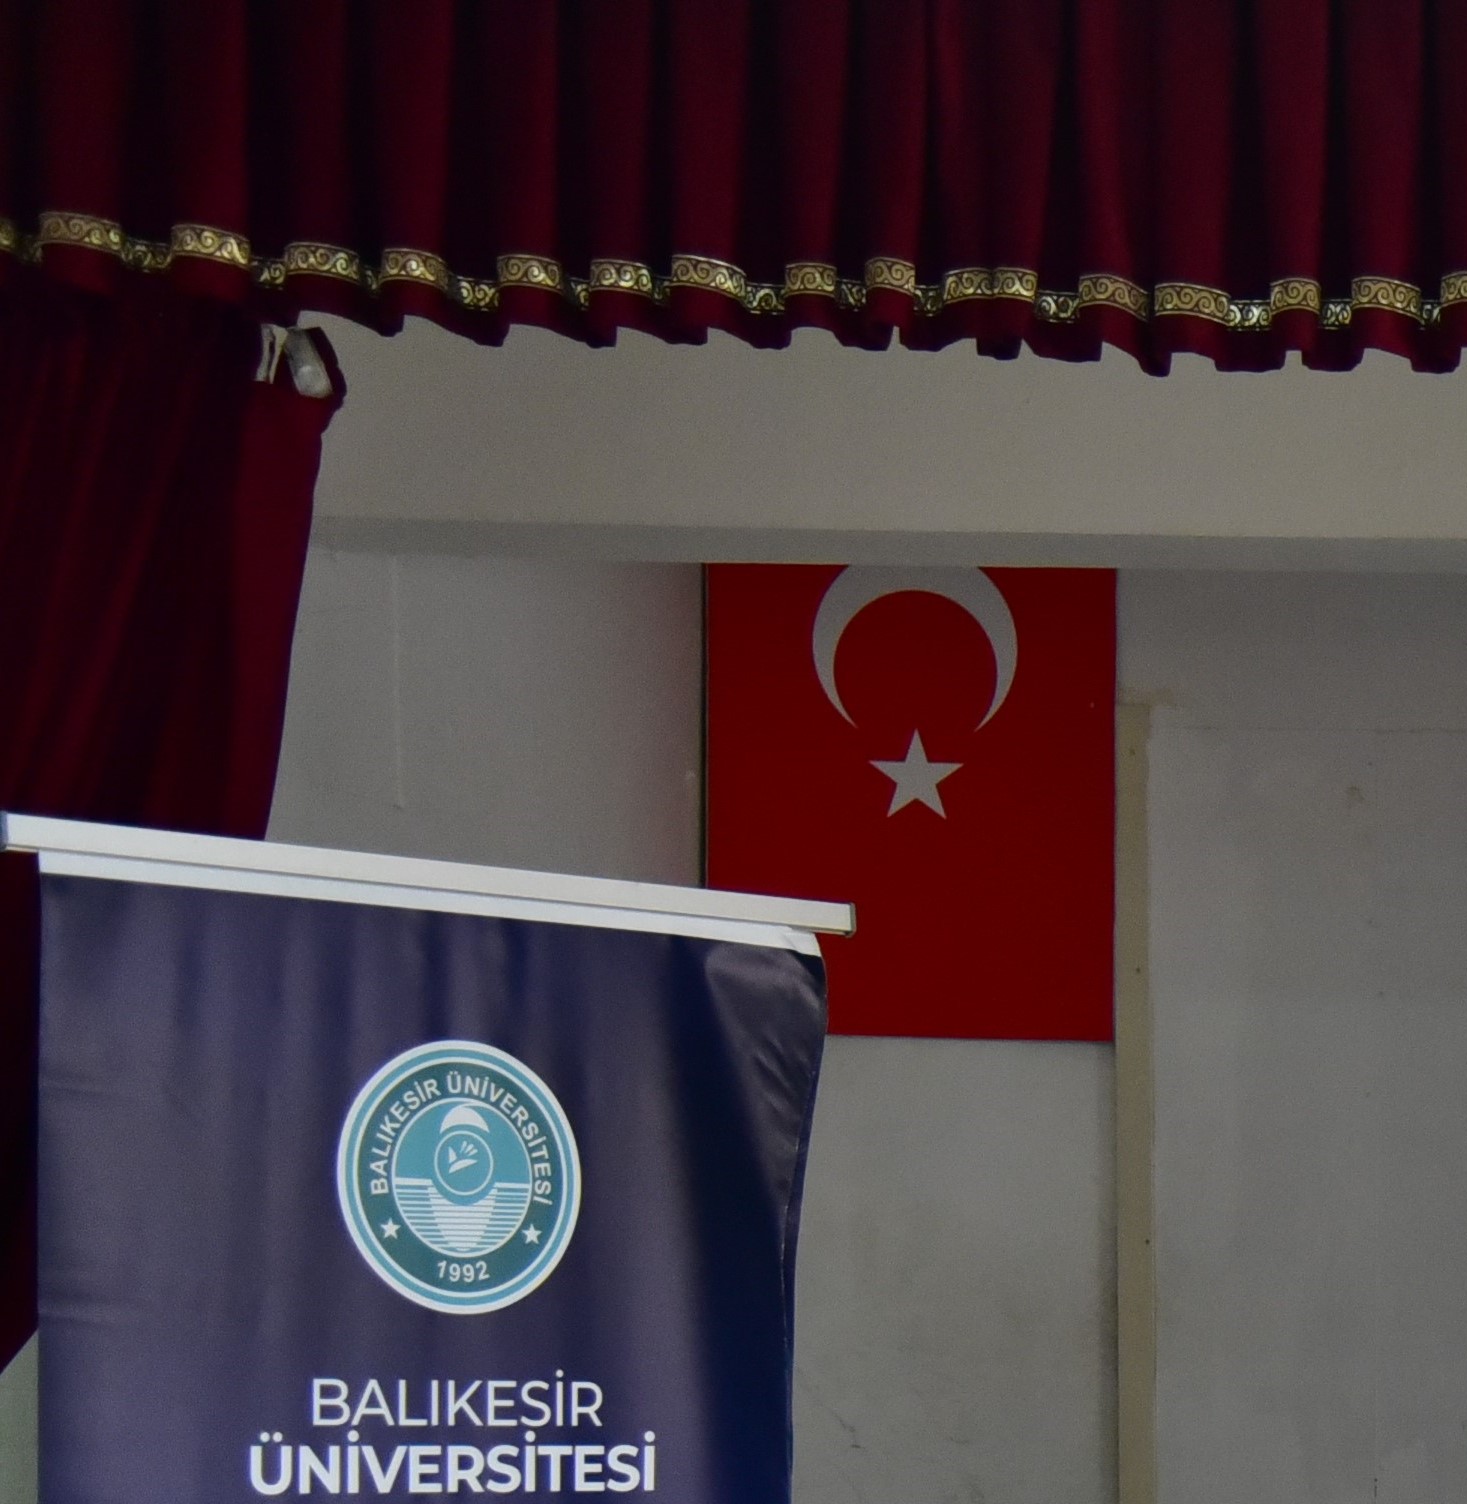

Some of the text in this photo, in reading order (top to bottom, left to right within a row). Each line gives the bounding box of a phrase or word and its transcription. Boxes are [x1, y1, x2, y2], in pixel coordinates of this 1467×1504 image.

[370, 1071, 553, 1206] BALIKESİR ÜNİVERSİTESİ
[437, 1260, 490, 1283] 1992
[312, 1369, 604, 1427] BALIKESİR
[249, 1429, 657, 1496] ÜNİVERSİTESİ
